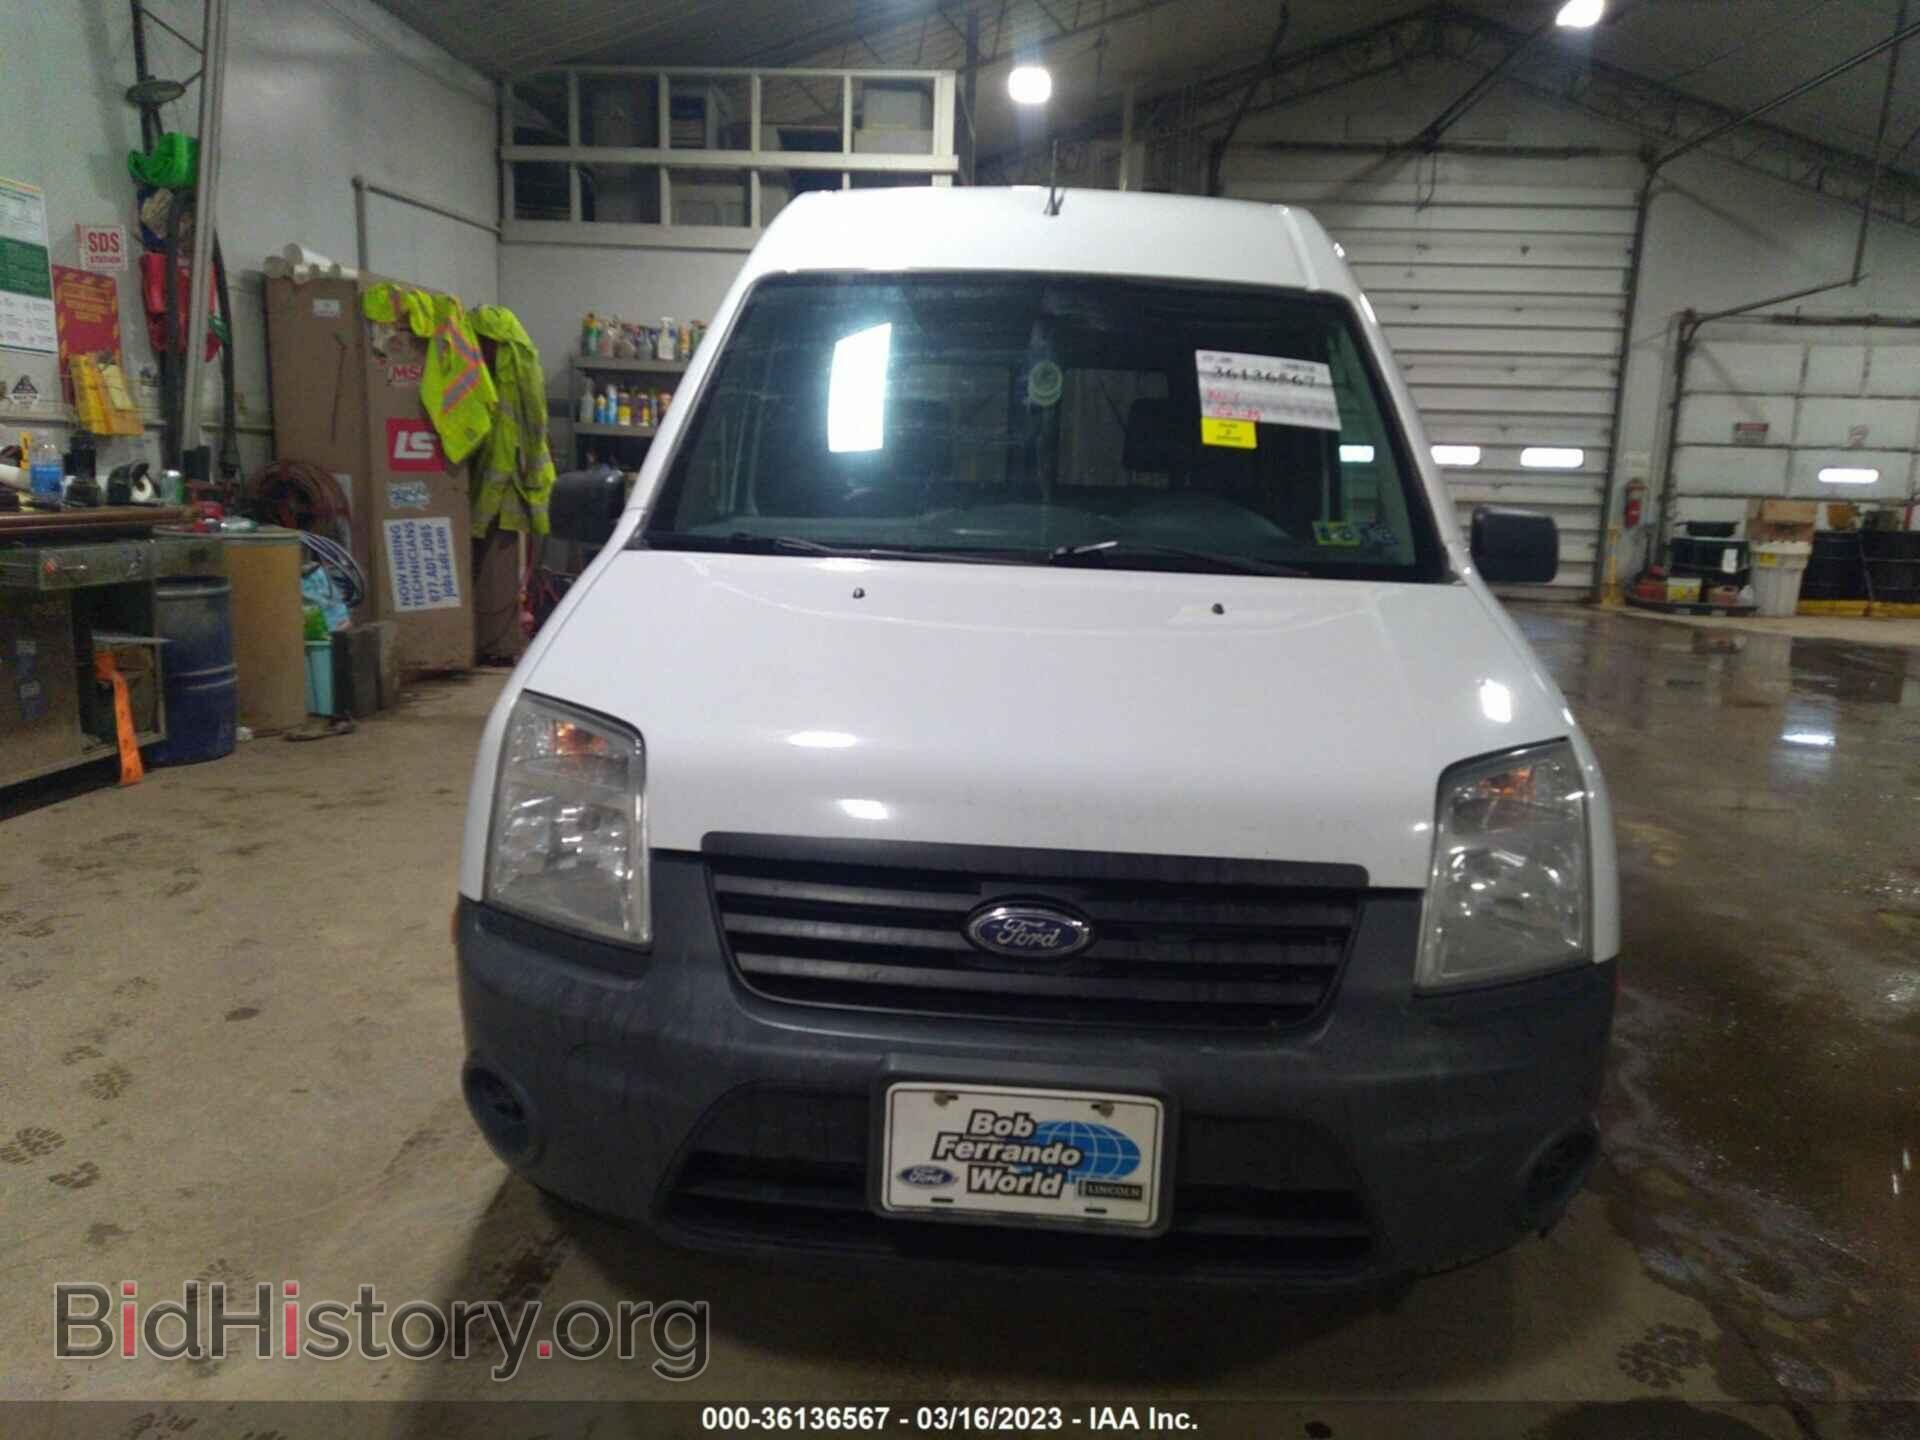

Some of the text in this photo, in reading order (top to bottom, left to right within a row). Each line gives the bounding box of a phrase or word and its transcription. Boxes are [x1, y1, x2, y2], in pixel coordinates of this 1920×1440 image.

[87, 232, 120, 253] SDS
[389, 525, 411, 607] NOW HIRING
[403, 521, 425, 607] TECHNICIANS
[996, 918, 1060, 948] Ford
[971, 1110, 1035, 1138] Bob
[932, 1134, 1082, 1168] Ferrando
[907, 1167, 945, 1185] Ford
[967, 1166, 1065, 1197] World
[1087, 1183, 1141, 1198] LINCOLN
